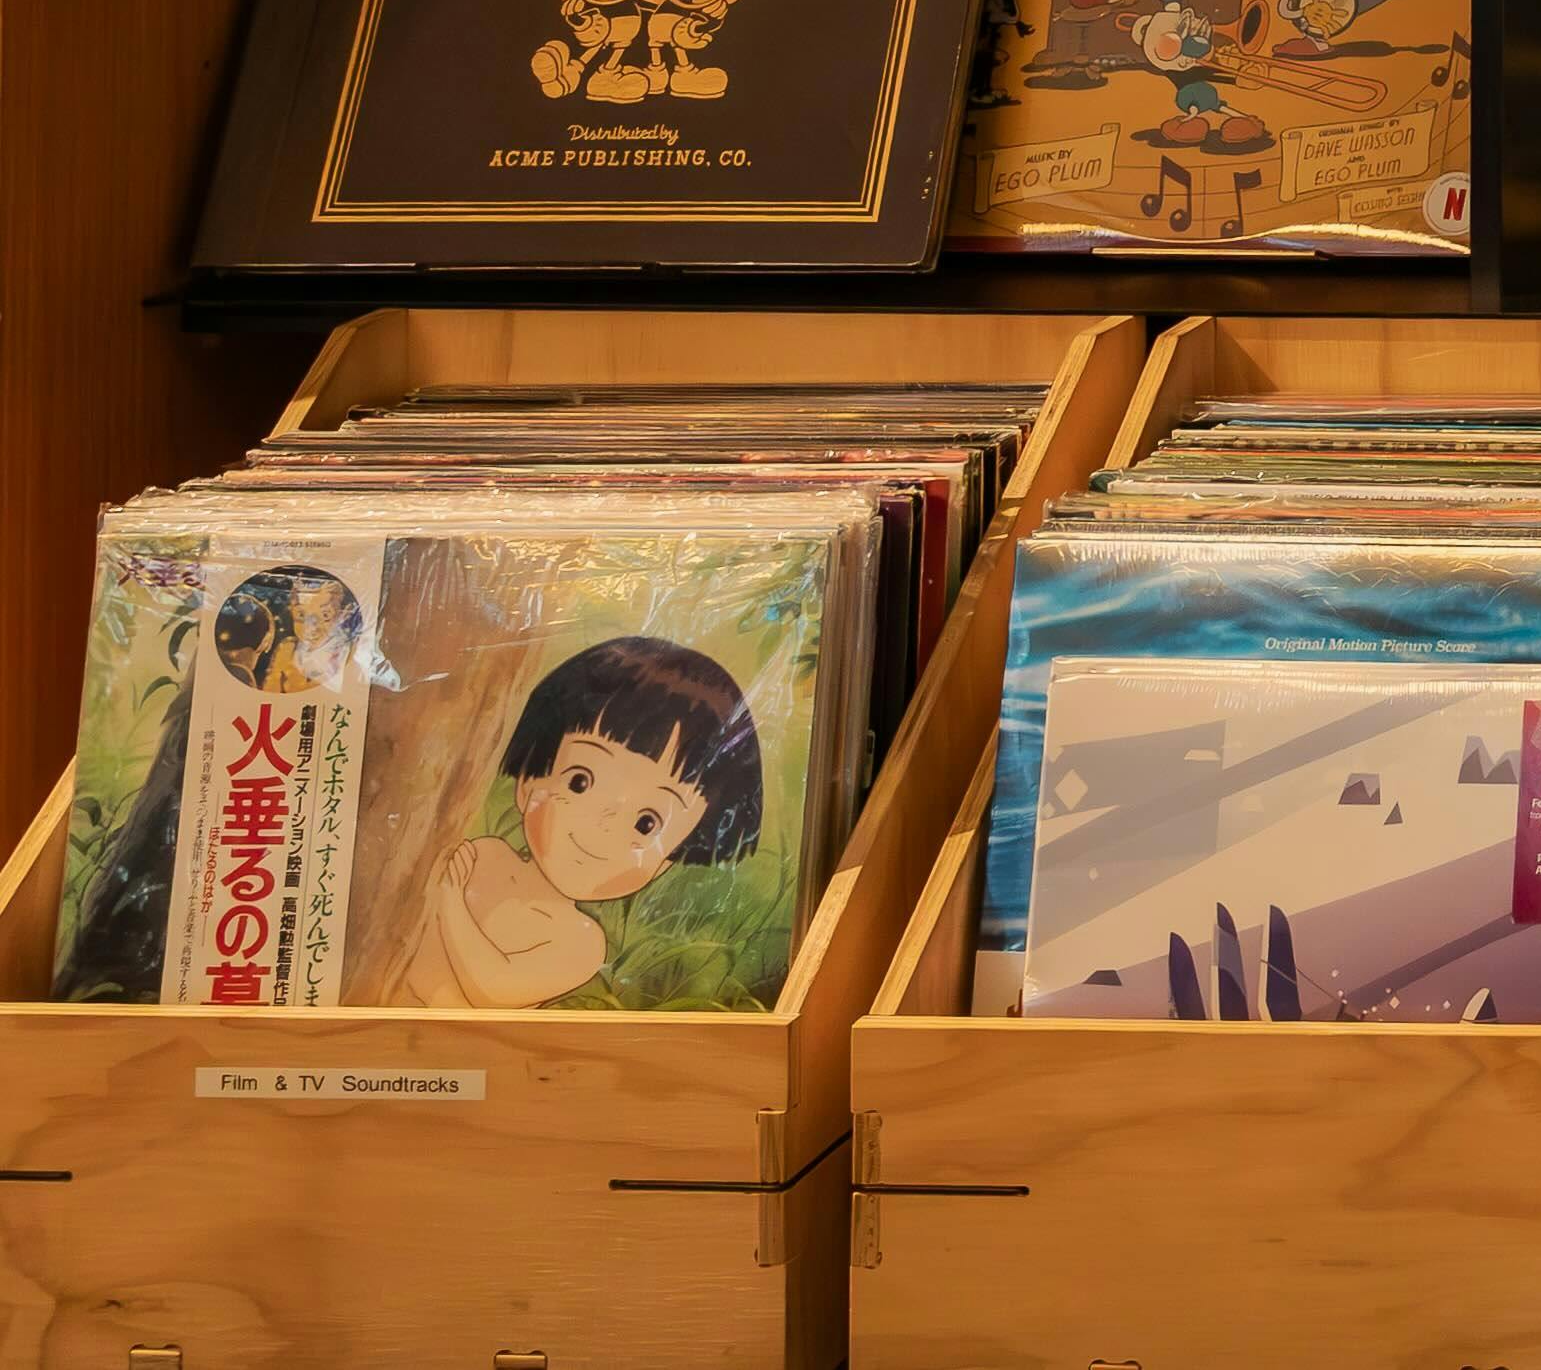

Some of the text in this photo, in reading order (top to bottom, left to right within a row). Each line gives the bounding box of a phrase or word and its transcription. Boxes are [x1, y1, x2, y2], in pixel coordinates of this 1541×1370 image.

[489, 150, 555, 168] ACME
[719, 150, 752, 167] CO.
[1264, 637, 1477, 655] Original Motion Picture Score
[221, 1075, 460, 1093] Film & TV Soundtracks
